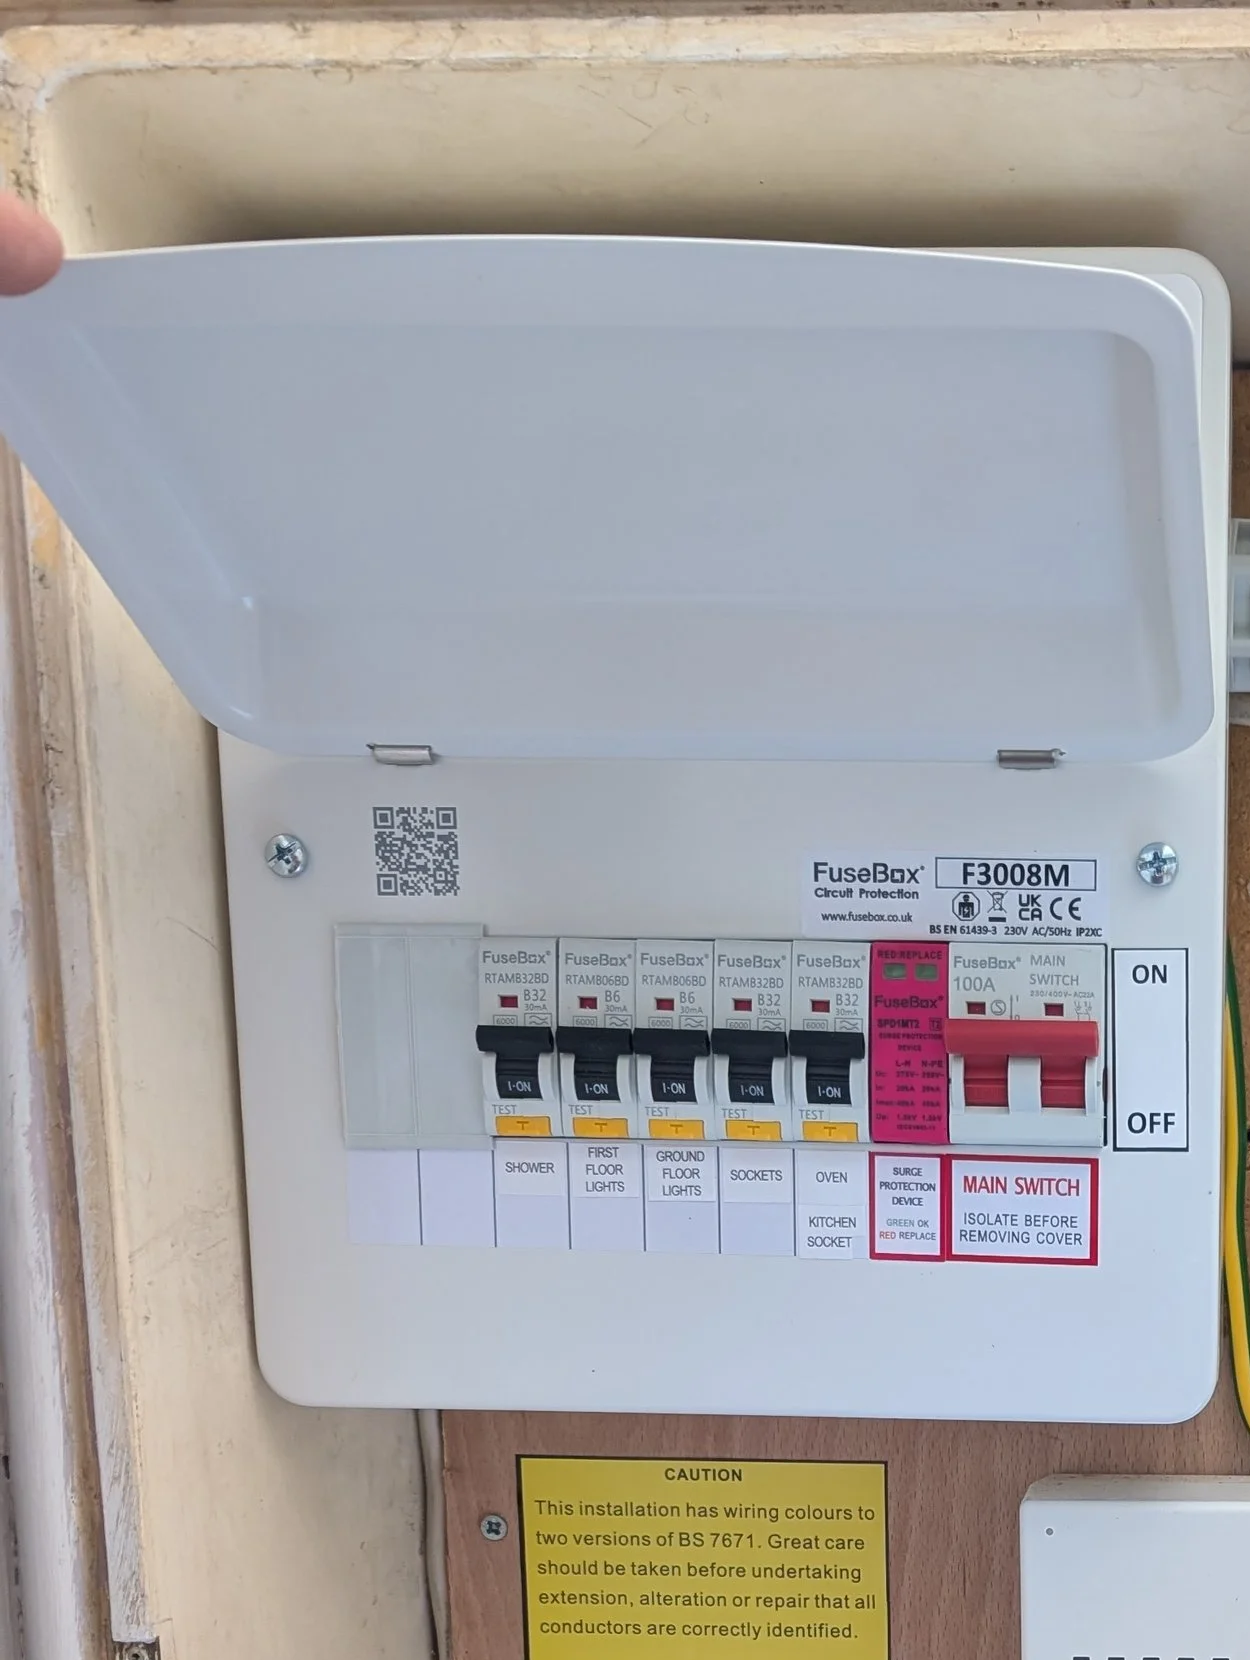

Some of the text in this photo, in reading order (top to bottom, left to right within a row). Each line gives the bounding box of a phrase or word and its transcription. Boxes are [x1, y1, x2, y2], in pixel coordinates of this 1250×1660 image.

[962, 863, 1070, 887] F3008M
[814, 888, 919, 899] Circuit Protection
[1018, 894, 1041, 907] UK
[1018, 908, 1042, 921] CA
[1050, 897, 1082, 921] CE
[822, 912, 912, 924] www.fusebox.co.uk
[930, 925, 1102, 938] BS EN 61439-3 230V AC/50Hz IP2XC
[1030, 954, 1065, 967] MAIN
[485, 973, 549, 984] RTAMB32BD
[565, 975, 630, 987] RTAMB06BD
[642, 975, 707, 987] RTAMB06BD
[1029, 974, 1079, 986] SWITCH
[1131, 964, 1168, 985] ON
[719, 977, 784, 988] RTAMB32BD
[799, 977, 863, 989] RTAMB32BD
[953, 976, 995, 992] 100A
[524, 989, 547, 1001] B32
[605, 990, 621, 1003] B6
[1127, 1112, 1176, 1134] OFF
[588, 1147, 619, 1159] FIRST
[656, 1150, 705, 1163] GROUND
[505, 1162, 555, 1174] SHOWER
[586, 1164, 623, 1176] FLOOR
[662, 1168, 700, 1180] FLOOR
[893, 1167, 922, 1177] SURGE
[730, 1169, 783, 1182] SOCKETS
[816, 1171, 848, 1184] OVEN
[586, 1181, 624, 1193] LIGHTS
[662, 1185, 701, 1197] LIGHTS
[879, 1181, 936, 1192] PROTECTION
[963, 1175, 1080, 1197] MAIN SWITCH
[892, 1197, 923, 1206] DEVICE
[808, 1216, 857, 1229] KITCHEN
[886, 1218, 929, 1228] GREEN OK
[964, 1212, 1078, 1228] ISOLATE BEFORE
[807, 1236, 853, 1249] SOCKET
[879, 1231, 936, 1241] RED REPLACE
[959, 1230, 1082, 1246] REMOVING COVER
[664, 1468, 743, 1482] CAUTION
[535, 1500, 875, 1522] This installation has wiring colours to
[535, 1532, 865, 1550] two versions of BS 7671. Great care
[537, 1560, 862, 1583] should be taken before undertaking
[539, 1590, 875, 1612] extension, alteration or repair that all
[539, 1619, 858, 1641] conductors are correctly identified.
